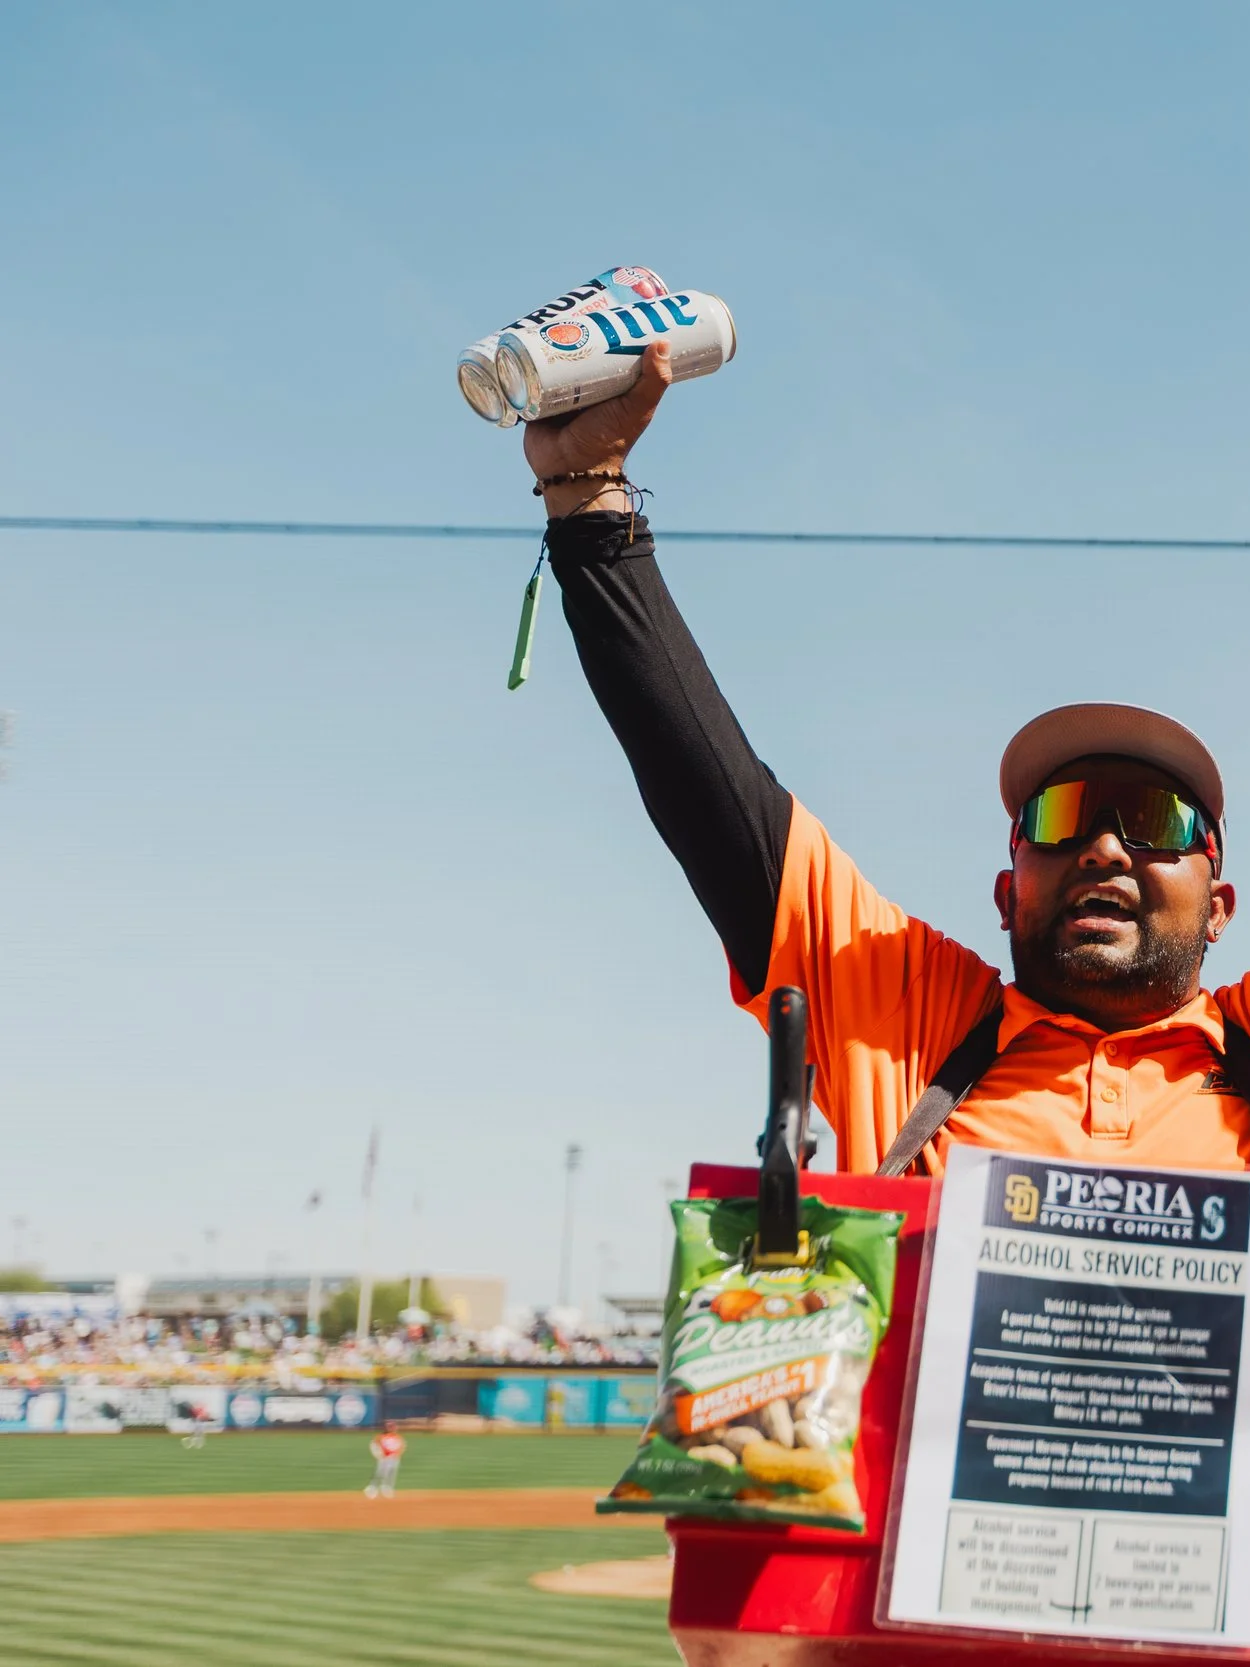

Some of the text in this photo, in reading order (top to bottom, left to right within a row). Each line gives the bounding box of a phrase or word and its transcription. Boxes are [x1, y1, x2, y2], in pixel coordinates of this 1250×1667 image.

[501, 279, 607, 330] TRULY
[584, 294, 699, 356] Lite
[1042, 1169, 1194, 1218] PEORIA
[1040, 1211, 1193, 1239] SPORTS COMPLEX
[979, 1238, 1243, 1284] ALCOHOL SERVICE POLICY
[671, 1302, 868, 1370] Peanuts
